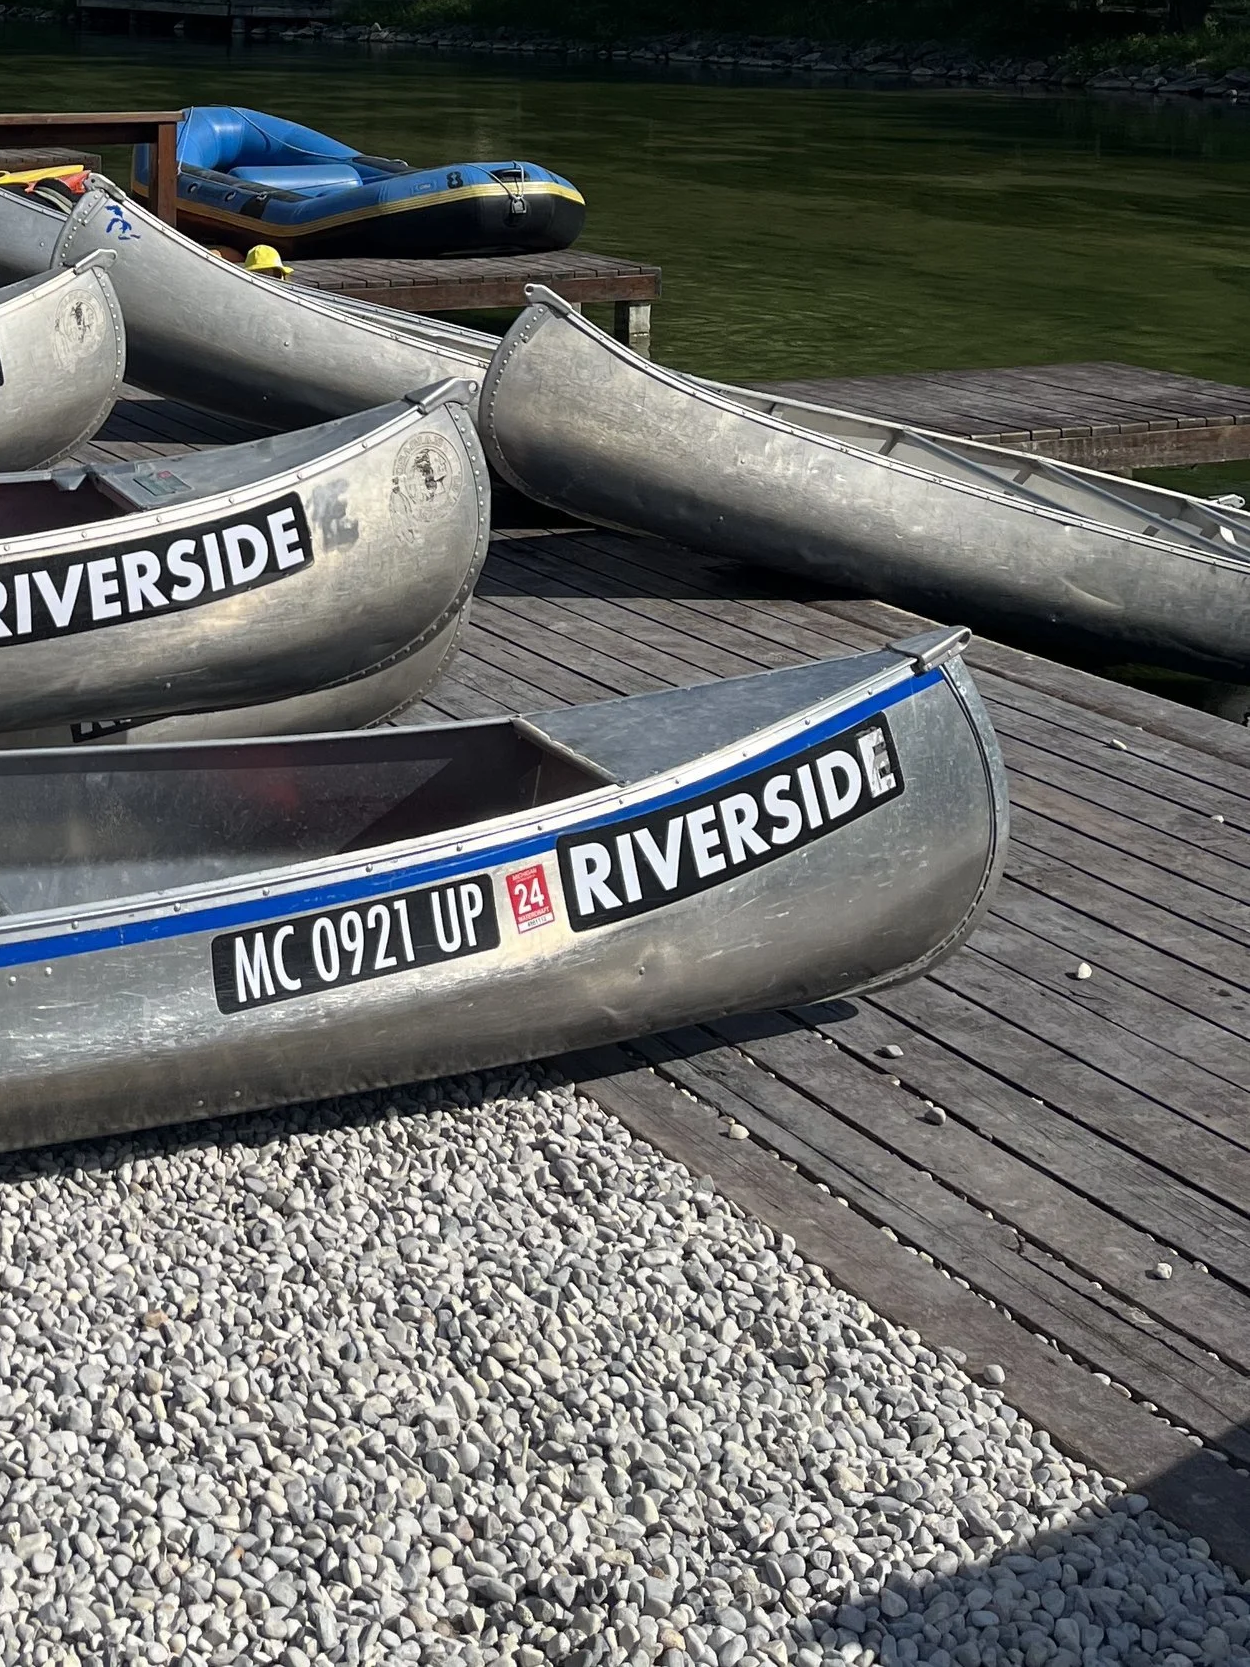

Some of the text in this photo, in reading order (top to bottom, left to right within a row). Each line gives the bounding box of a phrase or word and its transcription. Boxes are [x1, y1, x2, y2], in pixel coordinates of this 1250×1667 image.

[446, 171, 464, 188] 8
[569, 726, 897, 916] RIVERSIDE
[514, 877, 545, 914] 24
[235, 883, 484, 1003] MC 0921 UP
